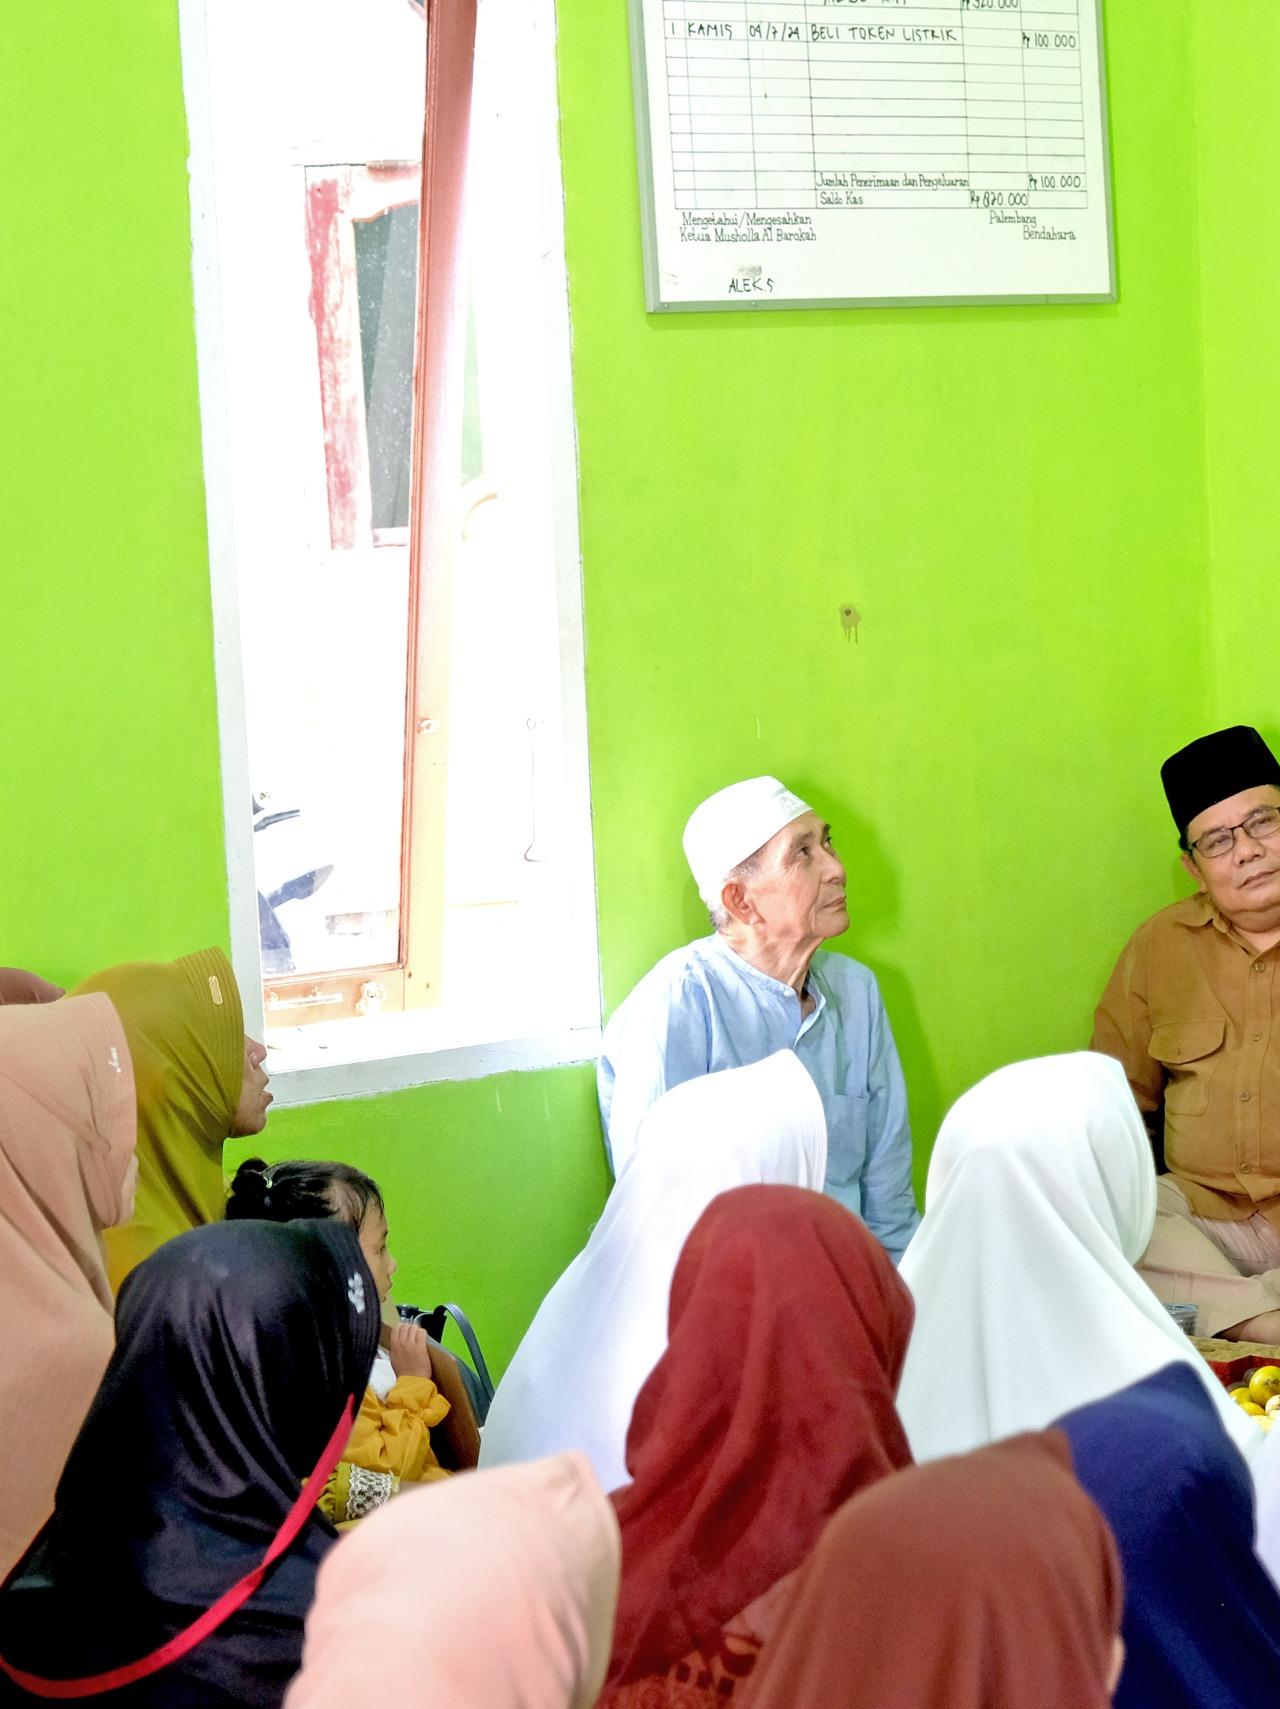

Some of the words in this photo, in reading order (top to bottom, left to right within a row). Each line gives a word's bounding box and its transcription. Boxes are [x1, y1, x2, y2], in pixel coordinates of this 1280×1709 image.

[687, 21, 733, 41] KAMIS
[811, 23, 840, 42] BELI
[848, 26, 895, 42] TOKEN
[902, 27, 958, 43] LISTRIK
[815, 172, 849, 187] Jumlah
[850, 173, 900, 188] Penerimaan
[901, 172, 918, 187] dan
[918, 173, 970, 191] Pengeluaran
[820, 191, 843, 206] Saldo
[845, 191, 864, 206] Kas
[989, 209, 1038, 229] Palembang
[680, 226, 712, 242] Ketua
[714, 227, 761, 243] Musholla
[762, 227, 774, 242] Al
[776, 227, 817, 242] Barokah
[1023, 224, 1077, 241] Bendahara
